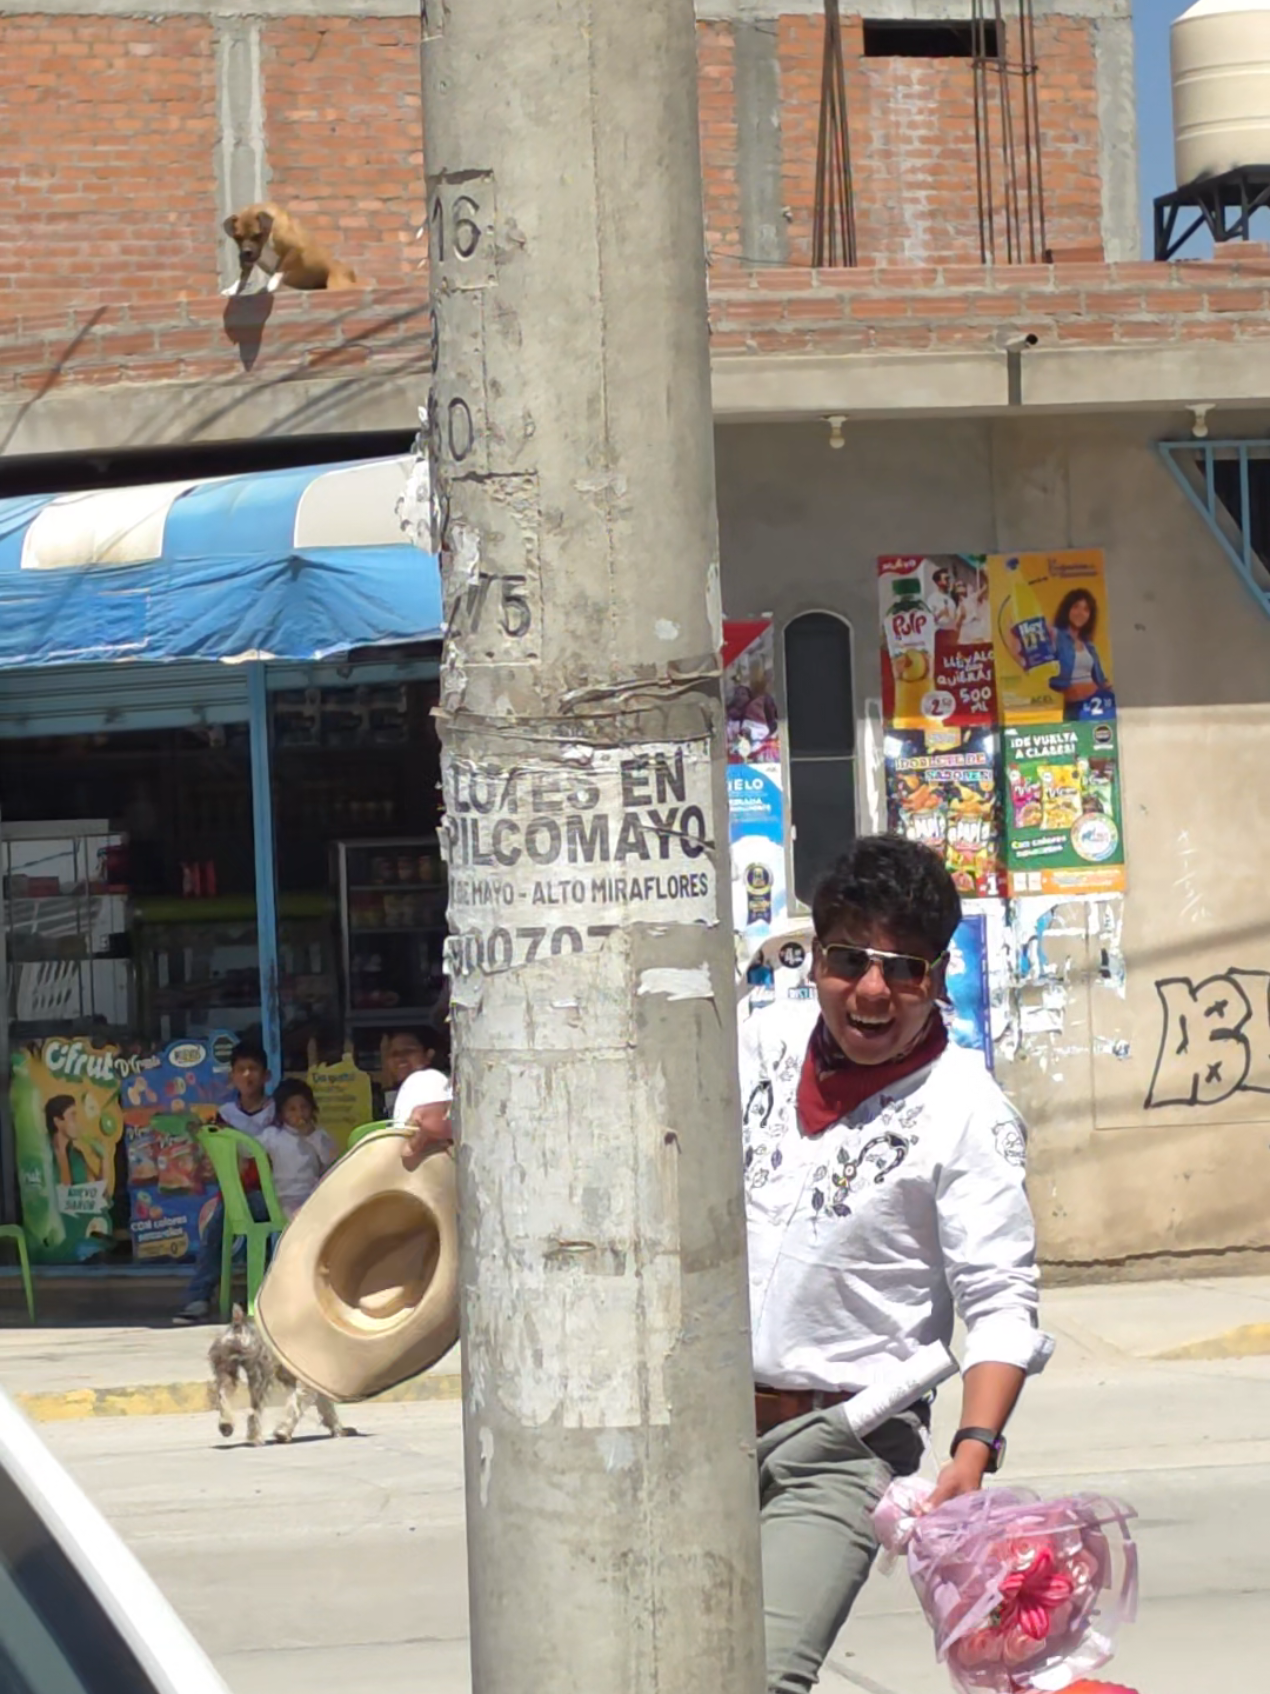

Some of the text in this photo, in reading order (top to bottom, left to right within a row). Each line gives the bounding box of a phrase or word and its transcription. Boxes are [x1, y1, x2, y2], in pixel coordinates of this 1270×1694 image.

[432, 195, 481, 262] 16
[960, 687, 991, 703] 500
[1032, 731, 1079, 747] VUELTA
[620, 746, 686, 808] EN
[445, 805, 706, 867] PILCOMAYO
[532, 879, 586, 905] ALTO
[591, 873, 709, 903] MIRAFLORES
[45, 1040, 115, 1081] Cifrut
